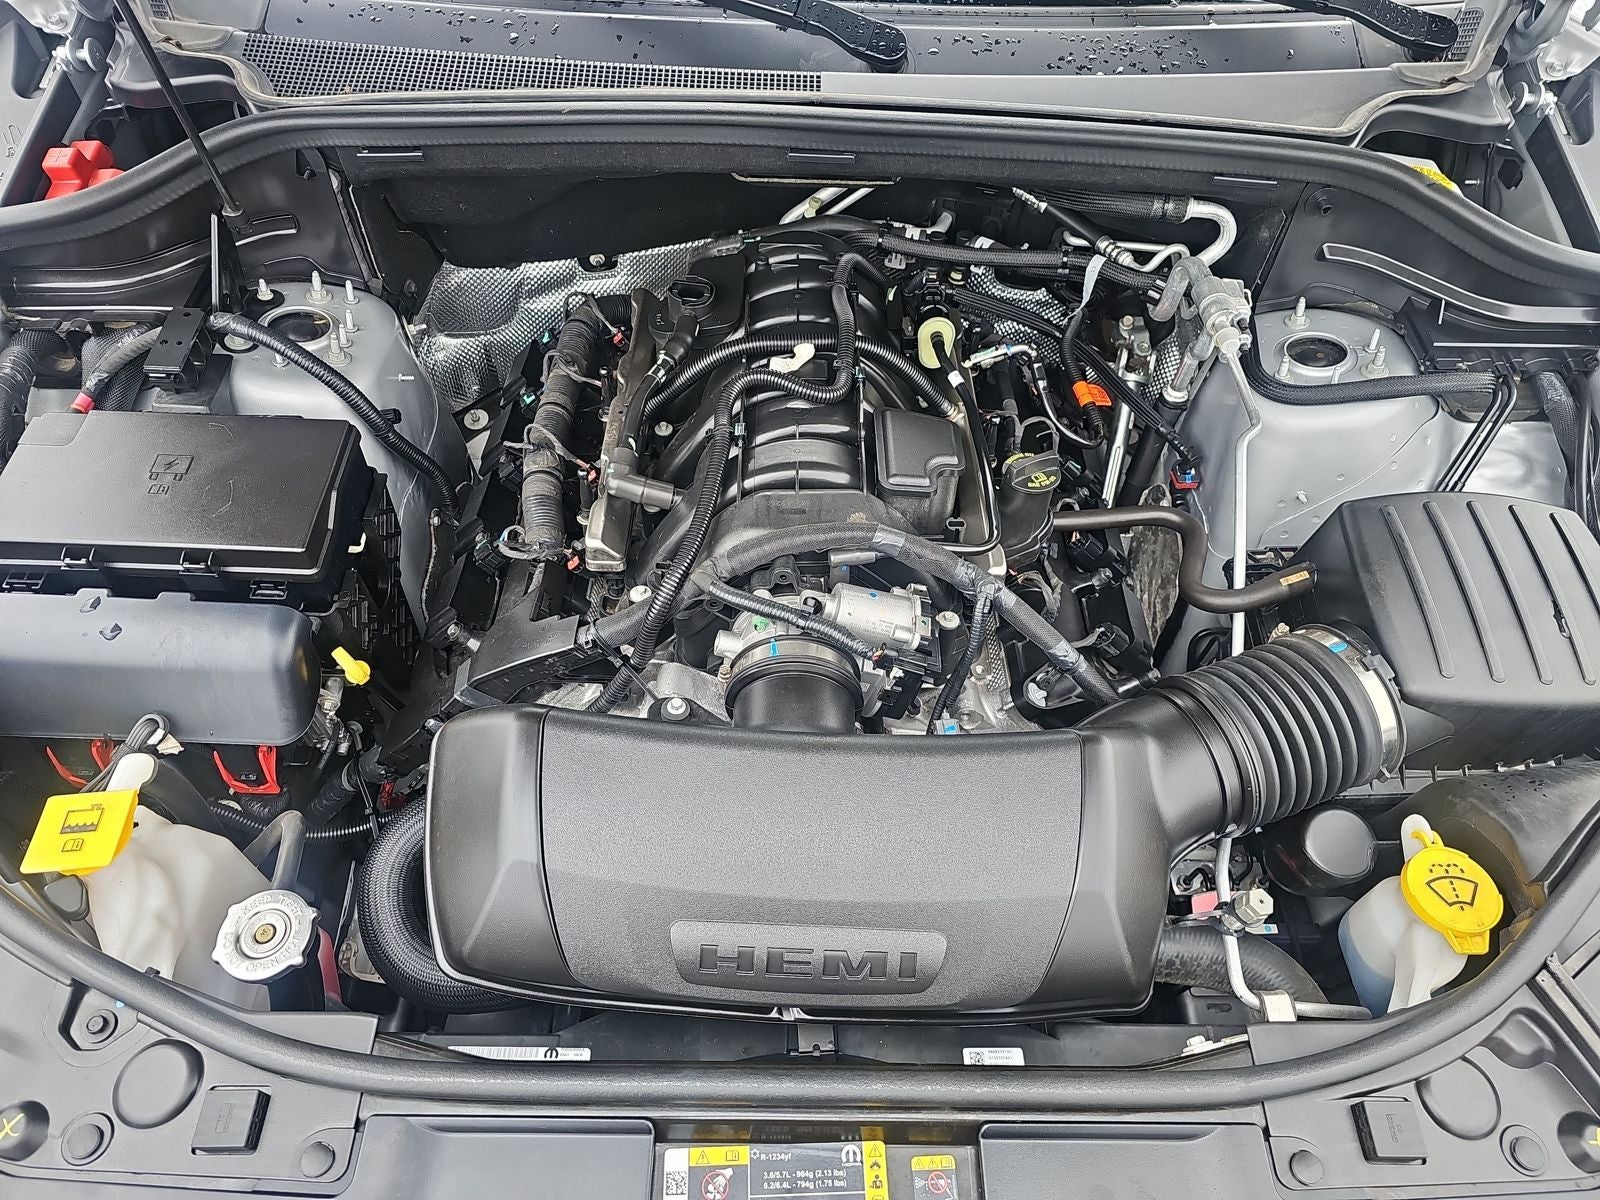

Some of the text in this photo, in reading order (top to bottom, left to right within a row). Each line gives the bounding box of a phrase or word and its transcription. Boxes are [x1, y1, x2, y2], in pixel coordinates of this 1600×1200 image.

[243, 895, 305, 917] KEEP TIGHT
[246, 956, 280, 973] OPEN
[699, 943, 918, 982] HEMI
[760, 1152, 792, 1161] R-1234yf
[763, 1171, 791, 1179] 3.6/5.7L
[796, 1170, 814, 1178] 964g
[815, 1169, 832, 1177] (2.13
[833, 1169, 847, 1177] lbs)
[763, 1181, 791, 1189] 6.2/6.4L
[796, 1181, 814, 1189] 794g
[815, 1180, 832, 1188] (1.75
[833, 1179, 847, 1187] lbs)
